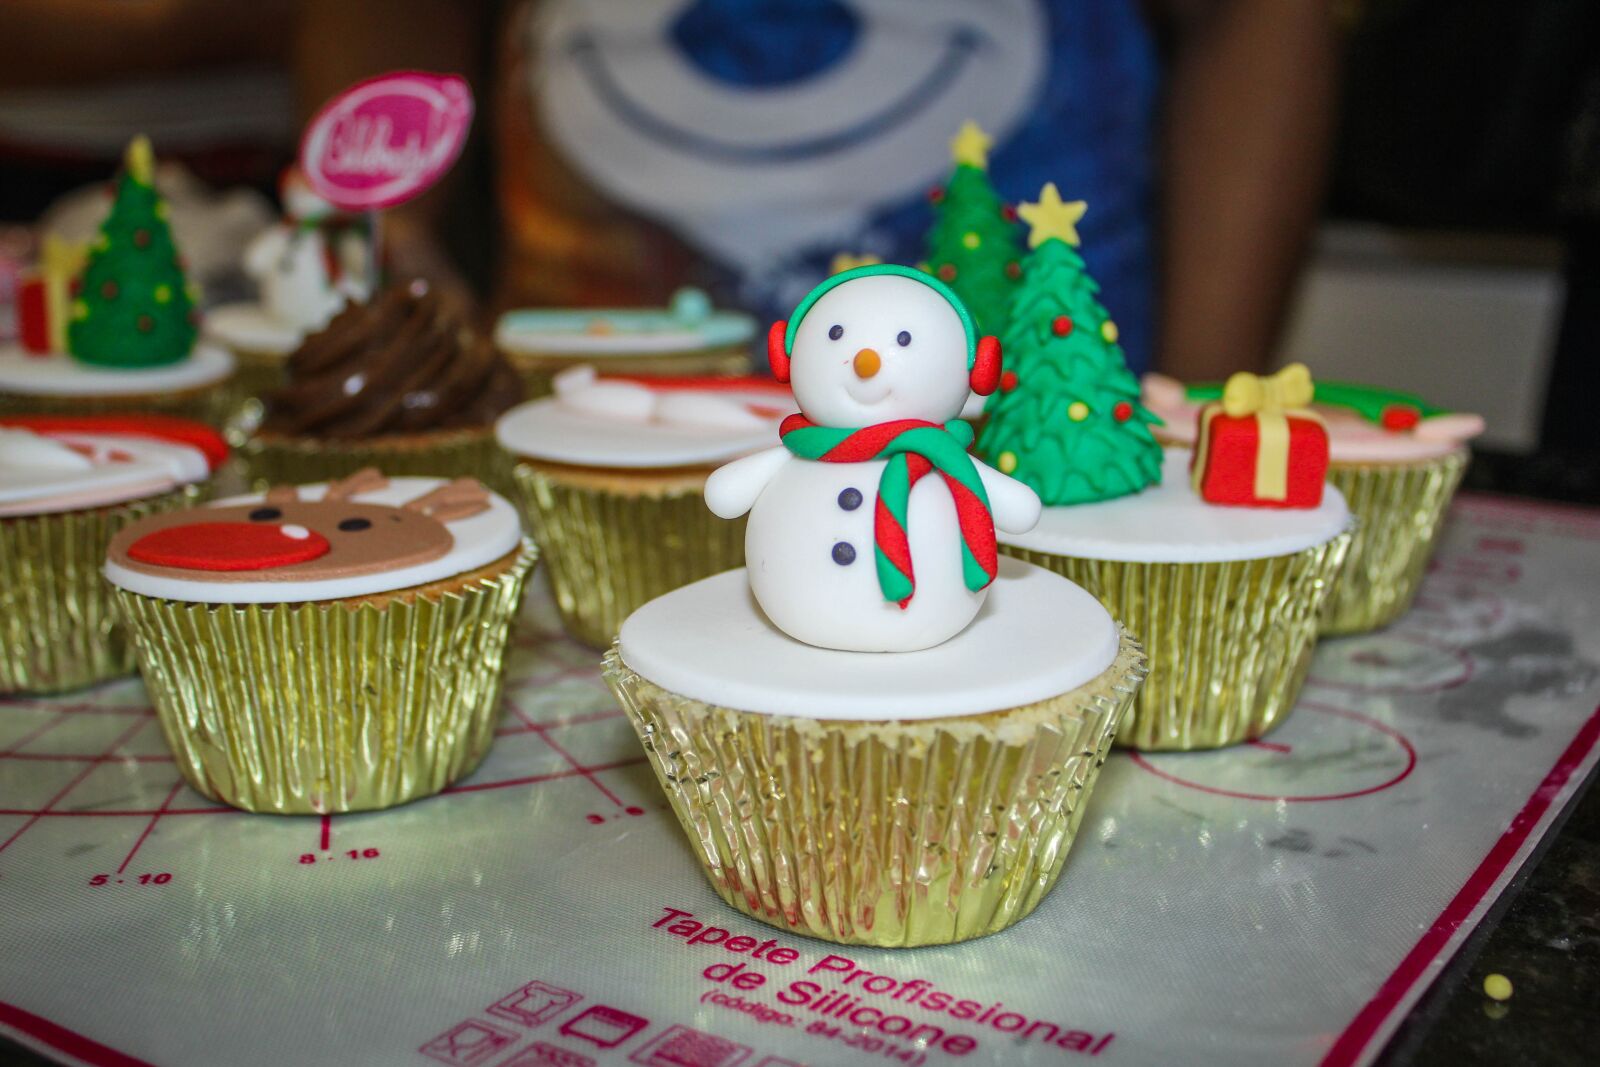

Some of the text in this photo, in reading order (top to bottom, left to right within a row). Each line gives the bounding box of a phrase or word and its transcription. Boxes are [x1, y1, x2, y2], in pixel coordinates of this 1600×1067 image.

[650, 907, 1116, 1057] Tapete Profissional
[701, 961, 979, 1057] de Silicone
